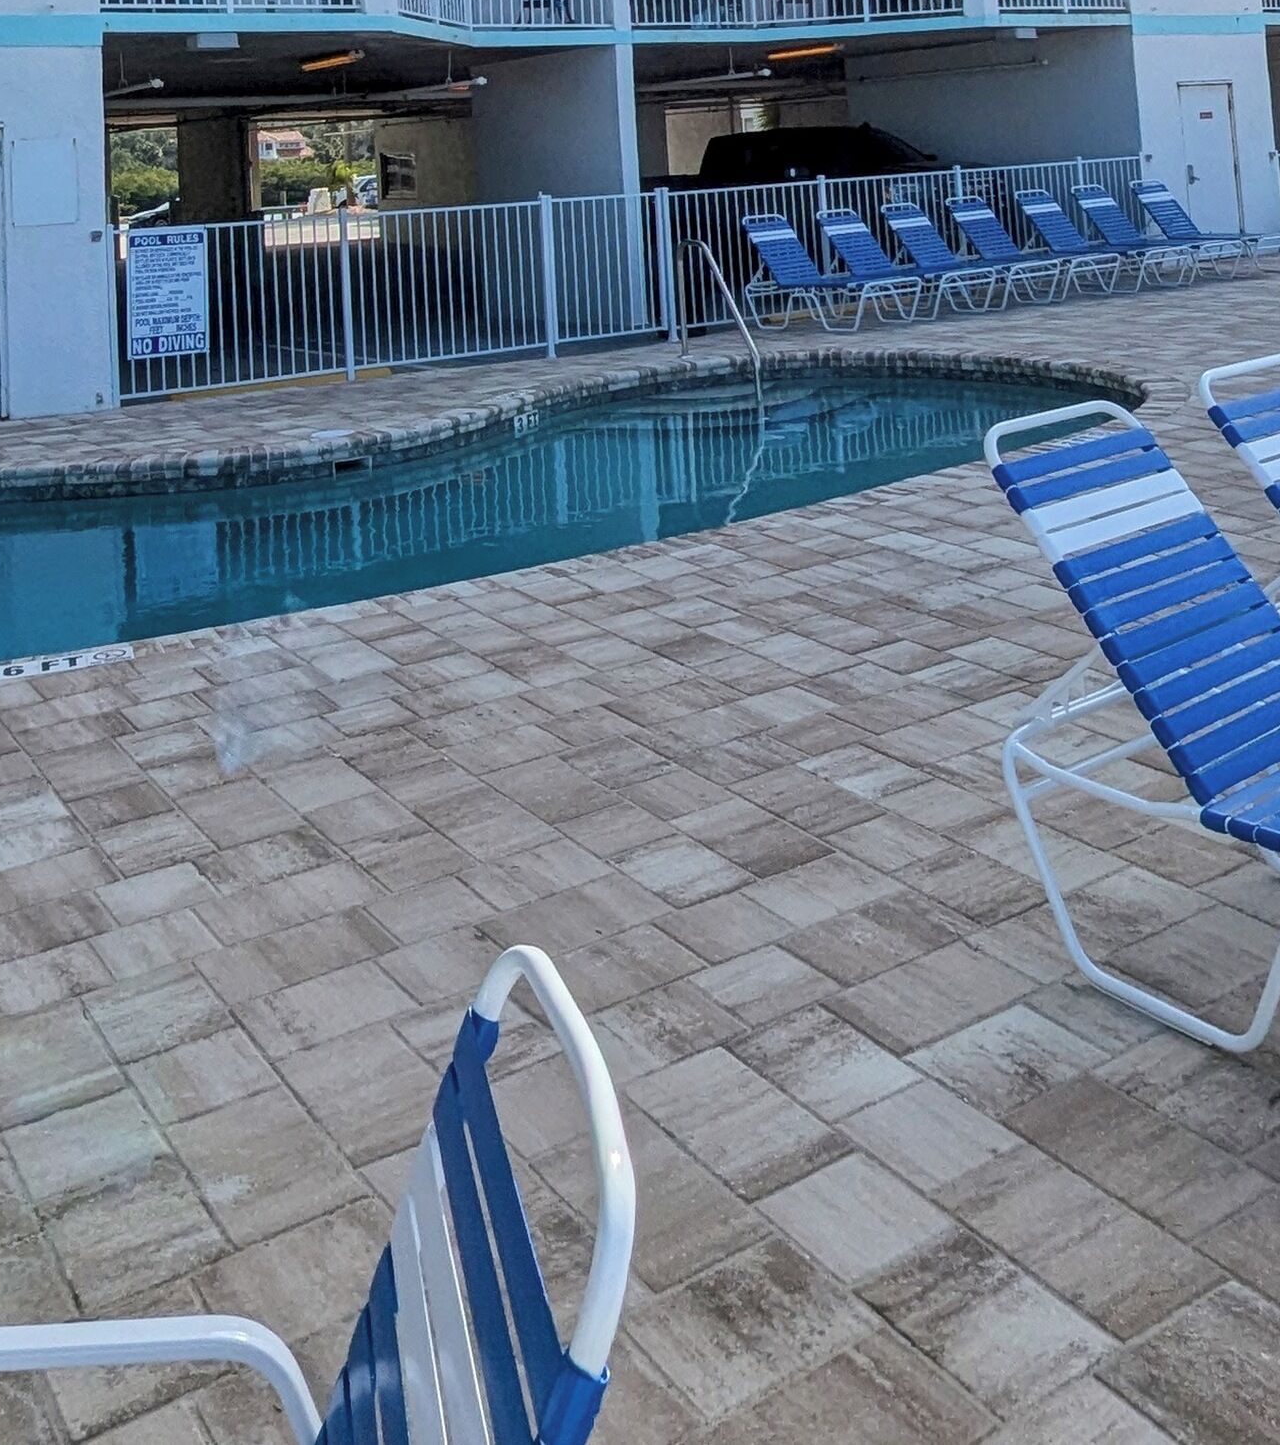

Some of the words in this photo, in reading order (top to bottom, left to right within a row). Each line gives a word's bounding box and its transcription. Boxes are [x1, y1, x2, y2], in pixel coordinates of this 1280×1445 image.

[134, 236, 162, 246] POOL
[166, 233, 199, 244] RULES
[135, 317, 151, 327] POOL
[152, 315, 180, 325] MAXIMUM
[148, 326, 163, 335] FEET
[175, 322, 197, 332] INCHES
[132, 338, 152, 355] NO
[158, 333, 205, 353] DIVING
[2, 665, 24, 677] 6
[41, 655, 83, 672] FT
